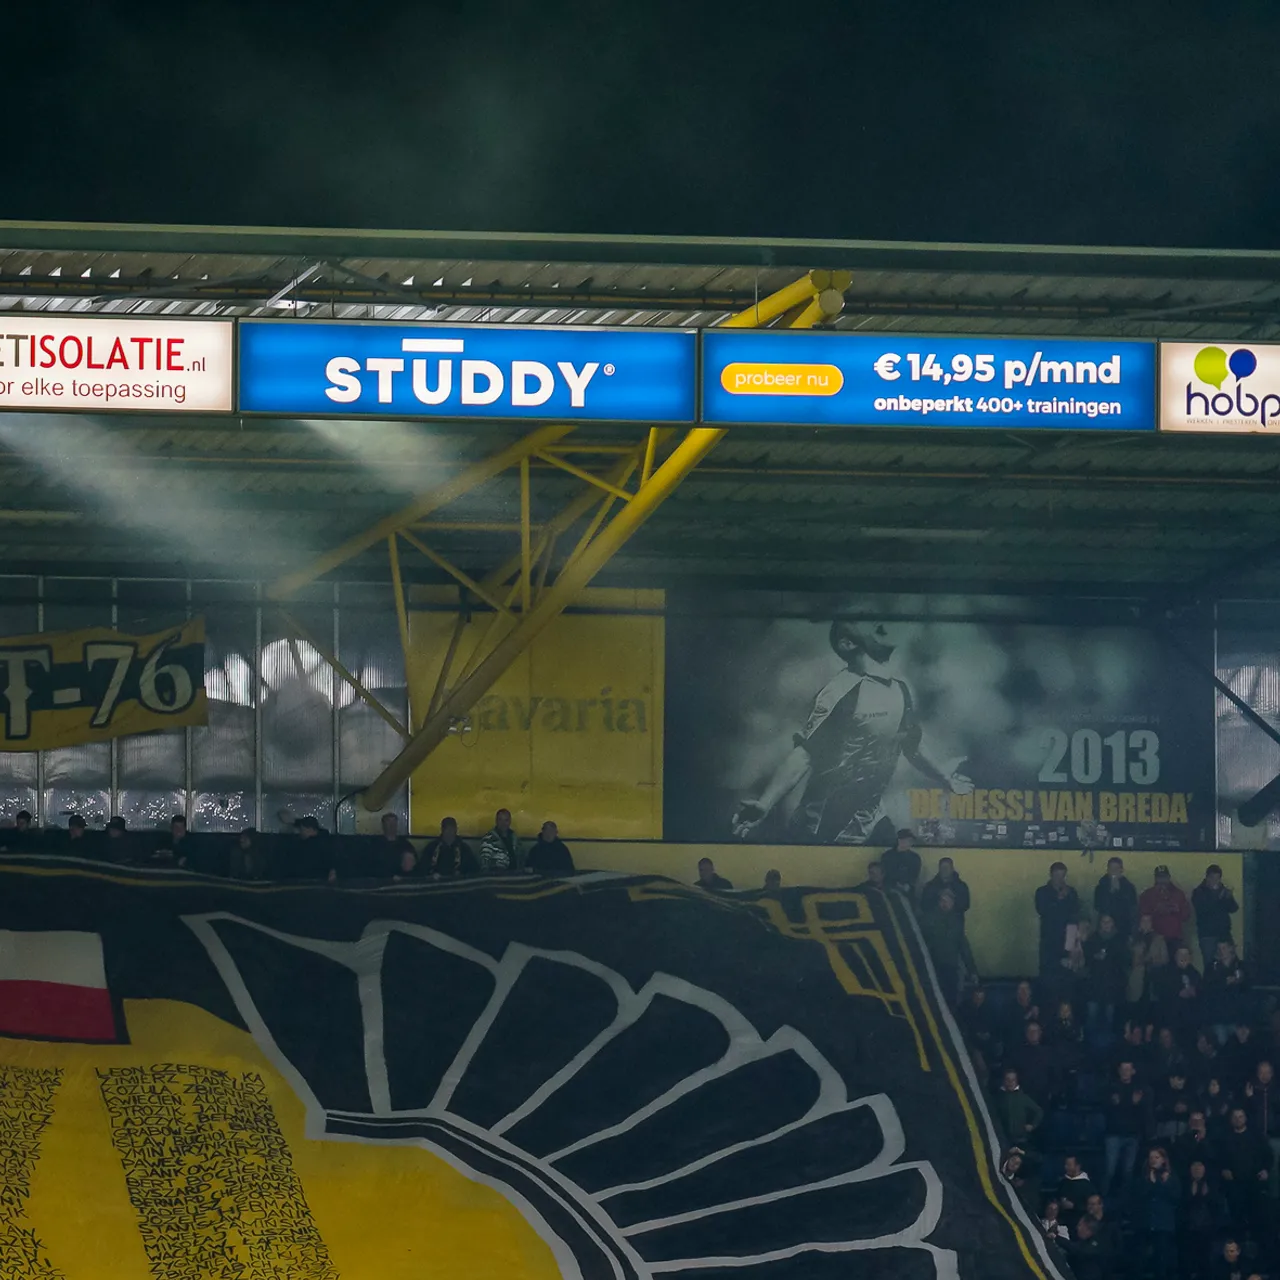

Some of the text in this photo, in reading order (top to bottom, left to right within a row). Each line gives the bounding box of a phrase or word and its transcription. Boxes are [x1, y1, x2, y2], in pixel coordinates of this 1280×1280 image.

[735, 370, 829, 390] probeer nu
[873, 351, 1121, 391] € 14,95 p/mnd
[20, 377, 64, 399] elke
[71, 378, 187, 403] toepassing
[873, 395, 1122, 419] onbeperkt 400+ trainingen
[470, 686, 648, 734] avaria
[1038, 728, 1160, 785] 2013
[951, 790, 1033, 822] MESS!
[1039, 790, 1093, 823] VAN
